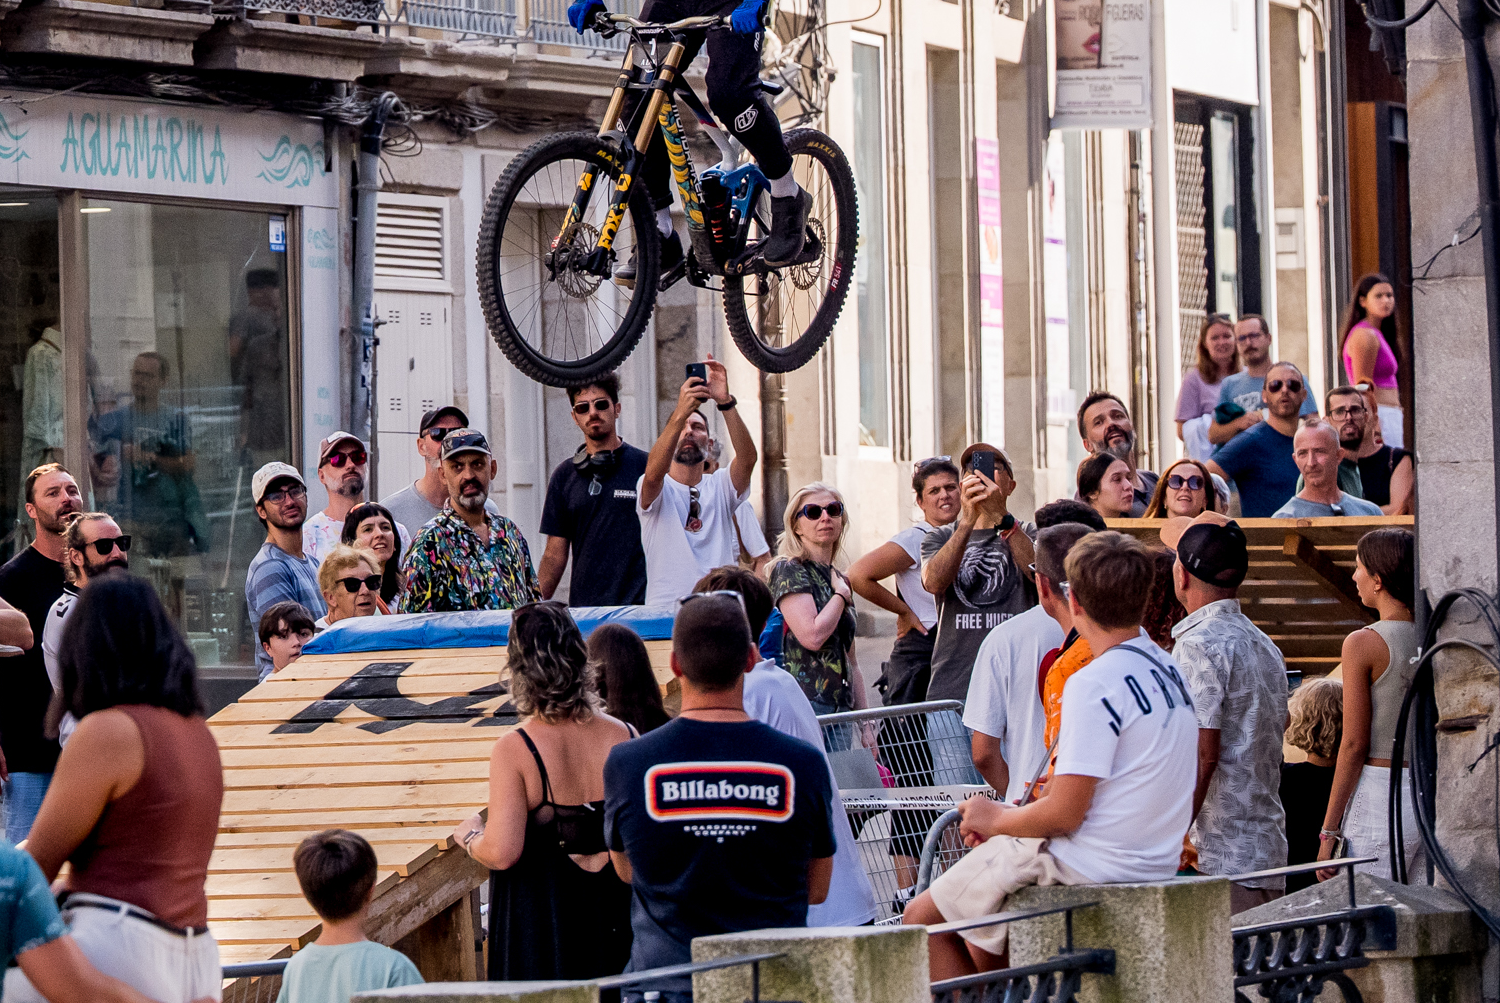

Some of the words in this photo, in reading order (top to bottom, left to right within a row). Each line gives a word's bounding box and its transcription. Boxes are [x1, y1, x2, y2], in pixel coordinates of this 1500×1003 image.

[59, 110, 230, 186] AGUAMARINA
[806, 140, 838, 159] MAXXIS
[955, 613, 983, 630] FREE
[661, 779, 780, 806] Billabong
